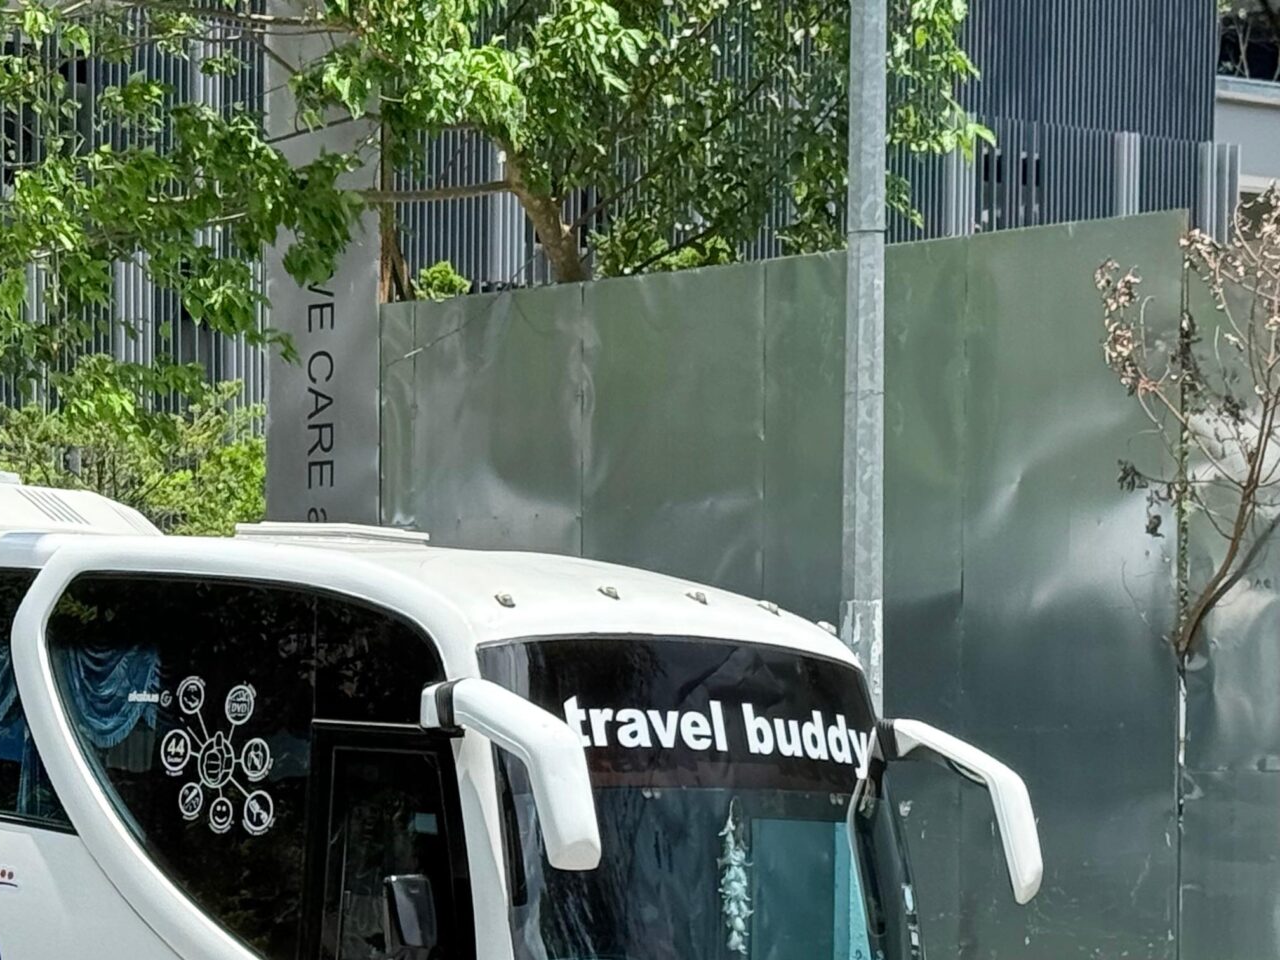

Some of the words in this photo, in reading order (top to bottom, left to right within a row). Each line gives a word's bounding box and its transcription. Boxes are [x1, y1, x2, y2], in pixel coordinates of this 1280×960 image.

[308, 351, 334, 489] CARE
[231, 702, 247, 713] DVD
[167, 737, 185, 756] 44
[563, 695, 728, 752] travel
[741, 703, 868, 779] buddy
